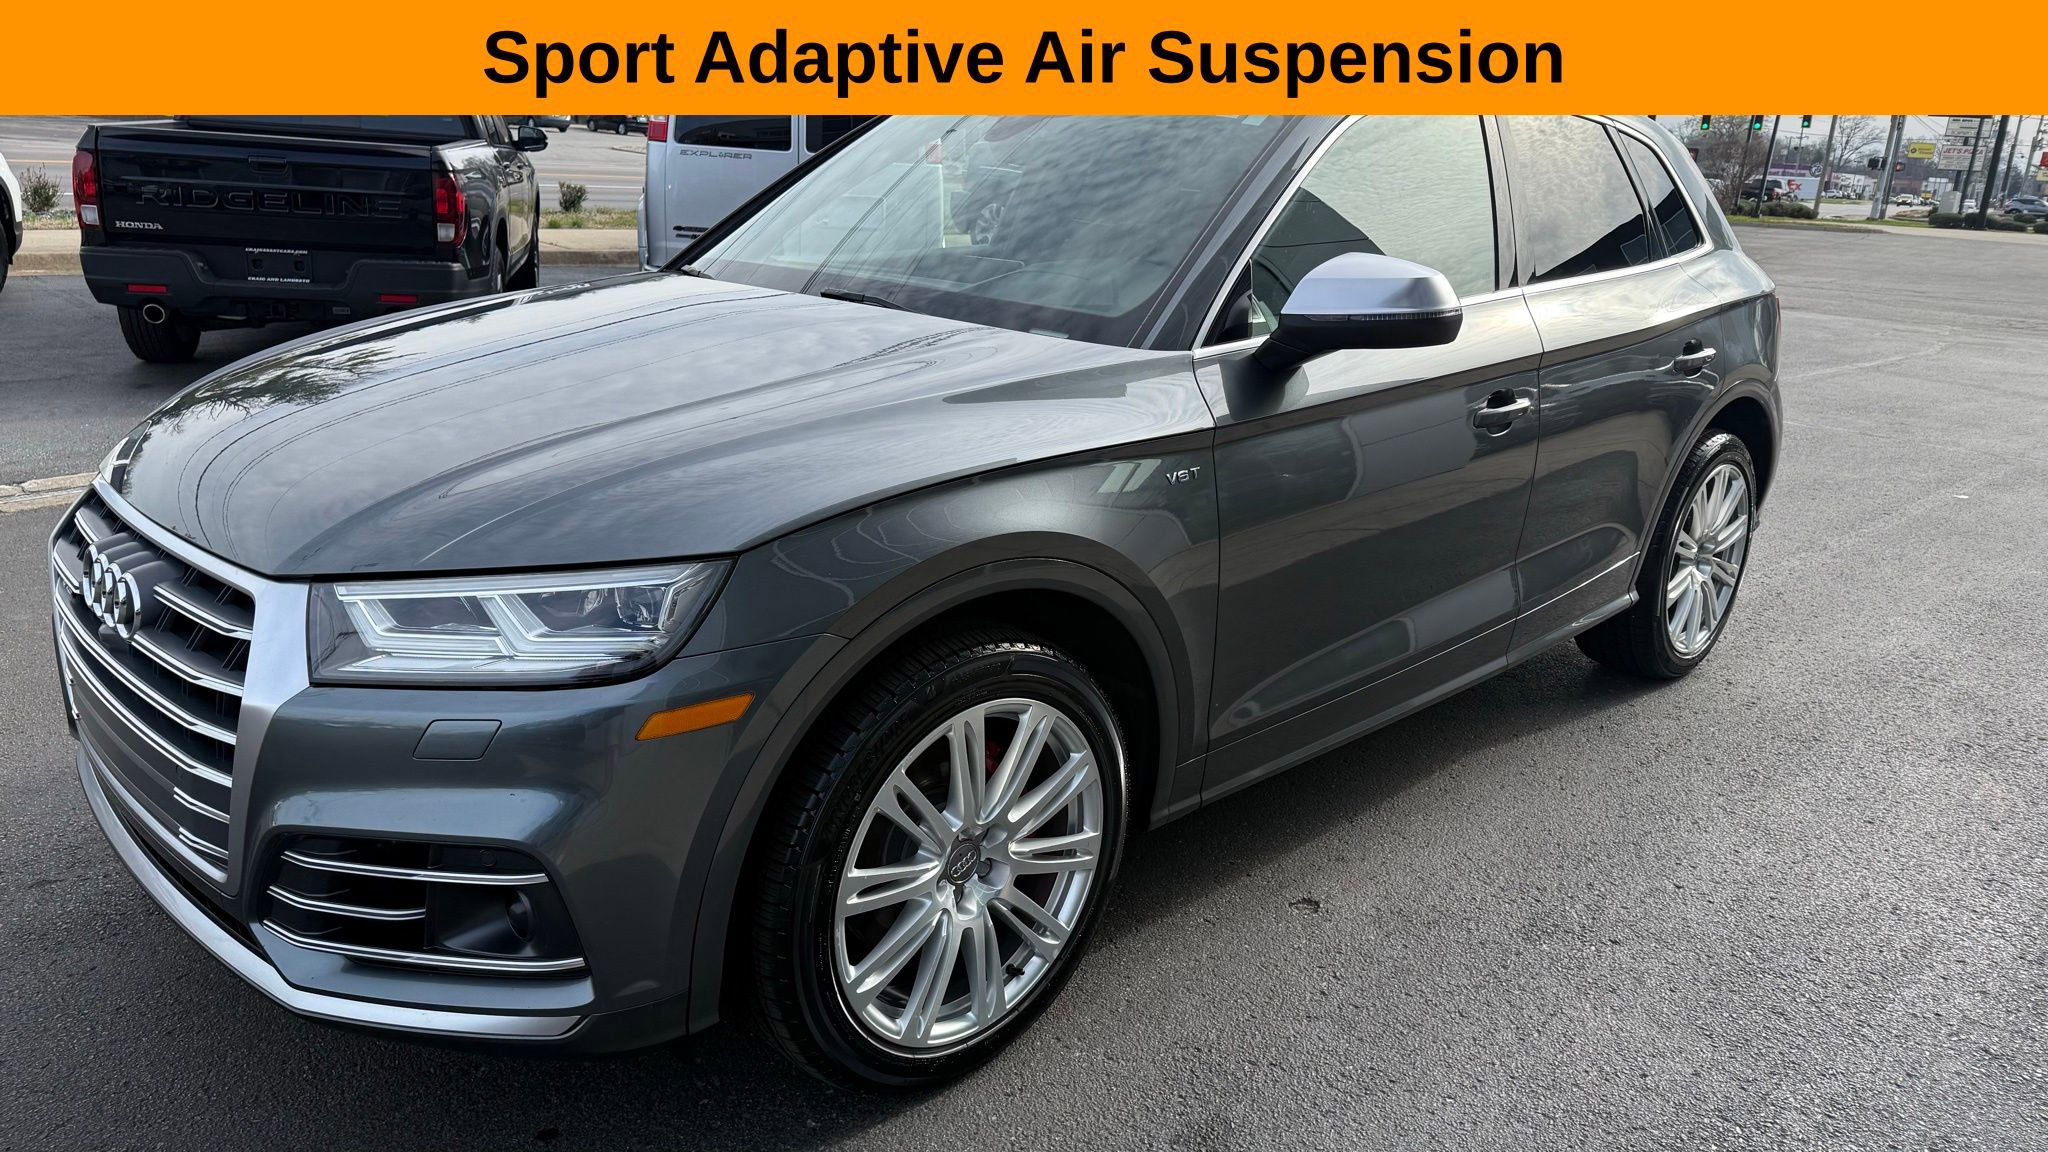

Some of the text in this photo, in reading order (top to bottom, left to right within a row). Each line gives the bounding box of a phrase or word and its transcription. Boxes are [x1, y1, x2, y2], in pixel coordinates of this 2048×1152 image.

[679, 149, 753, 160] EXPLORER
[135, 184, 403, 219] RIDGELINE
[115, 220, 164, 231] HONDA
